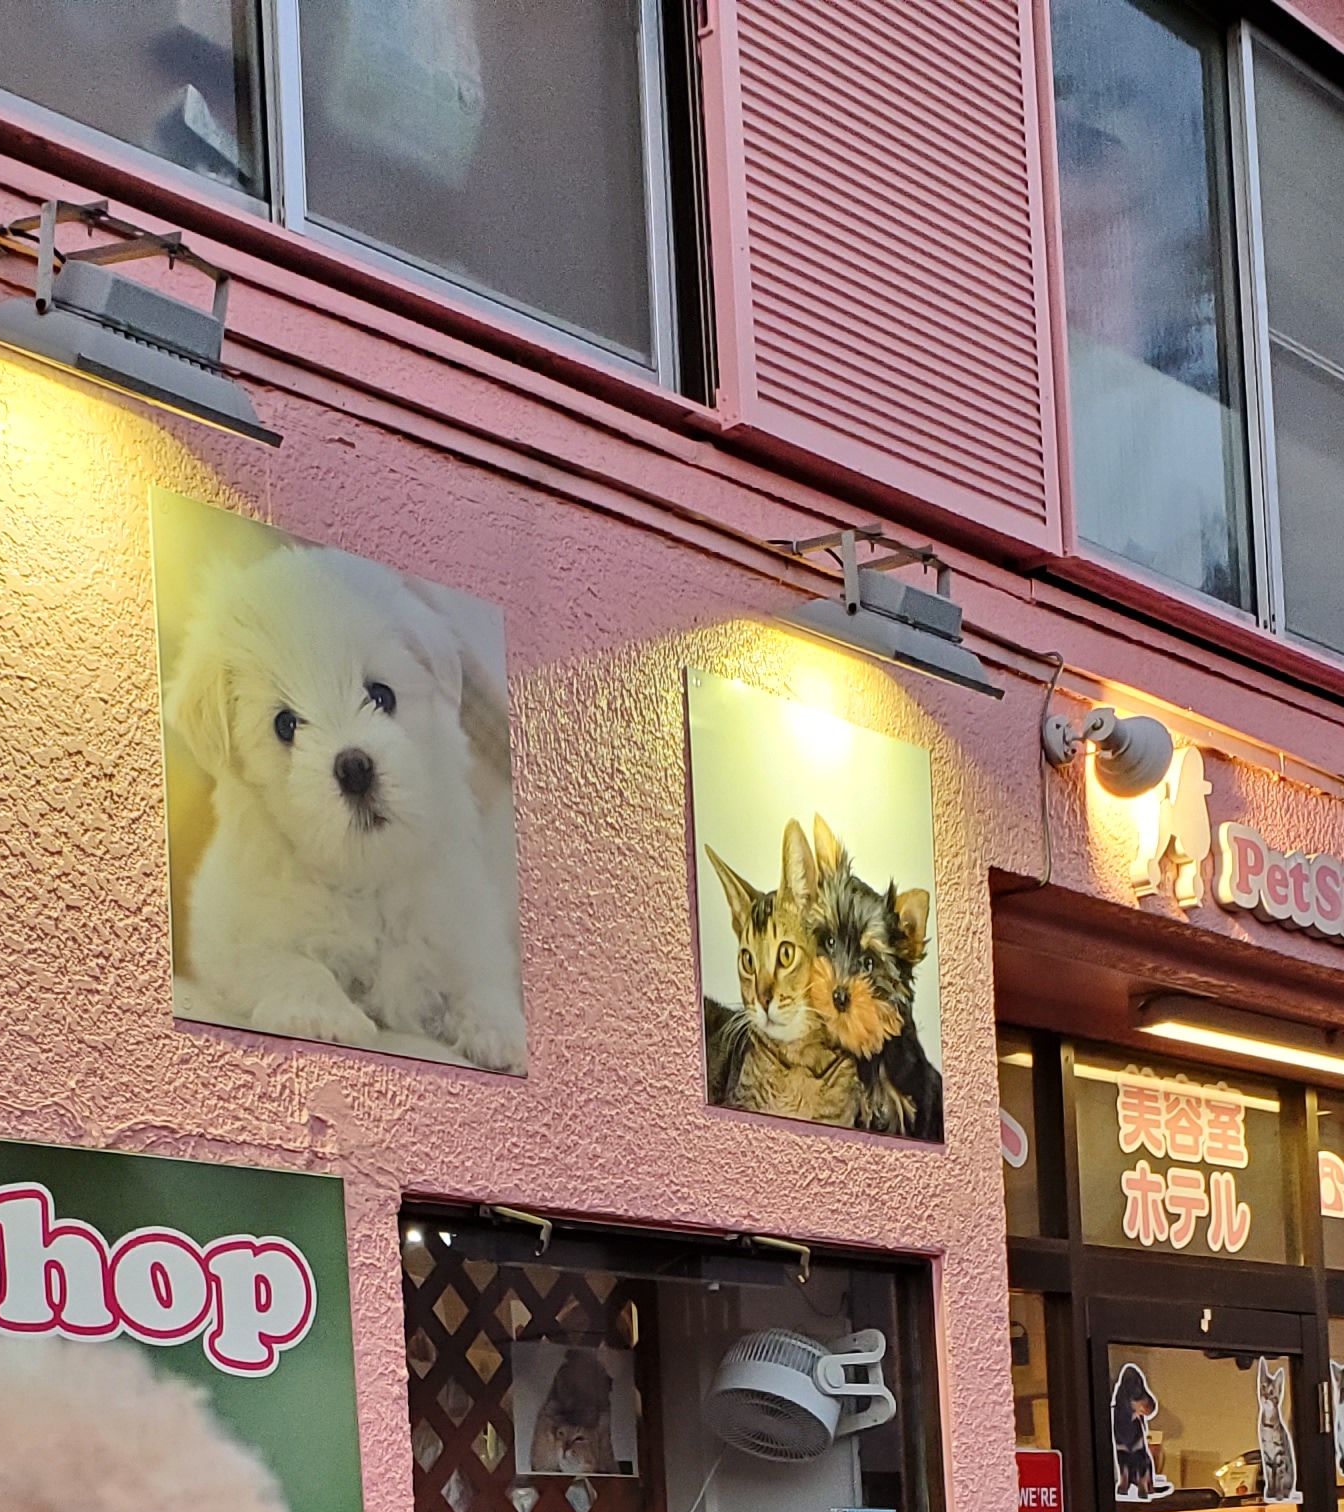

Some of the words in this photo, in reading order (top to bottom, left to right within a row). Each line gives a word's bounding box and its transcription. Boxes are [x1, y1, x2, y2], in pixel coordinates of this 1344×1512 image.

[1117, 1064, 1249, 1168] 美容室
[1121, 1160, 1251, 1252] ホテル
